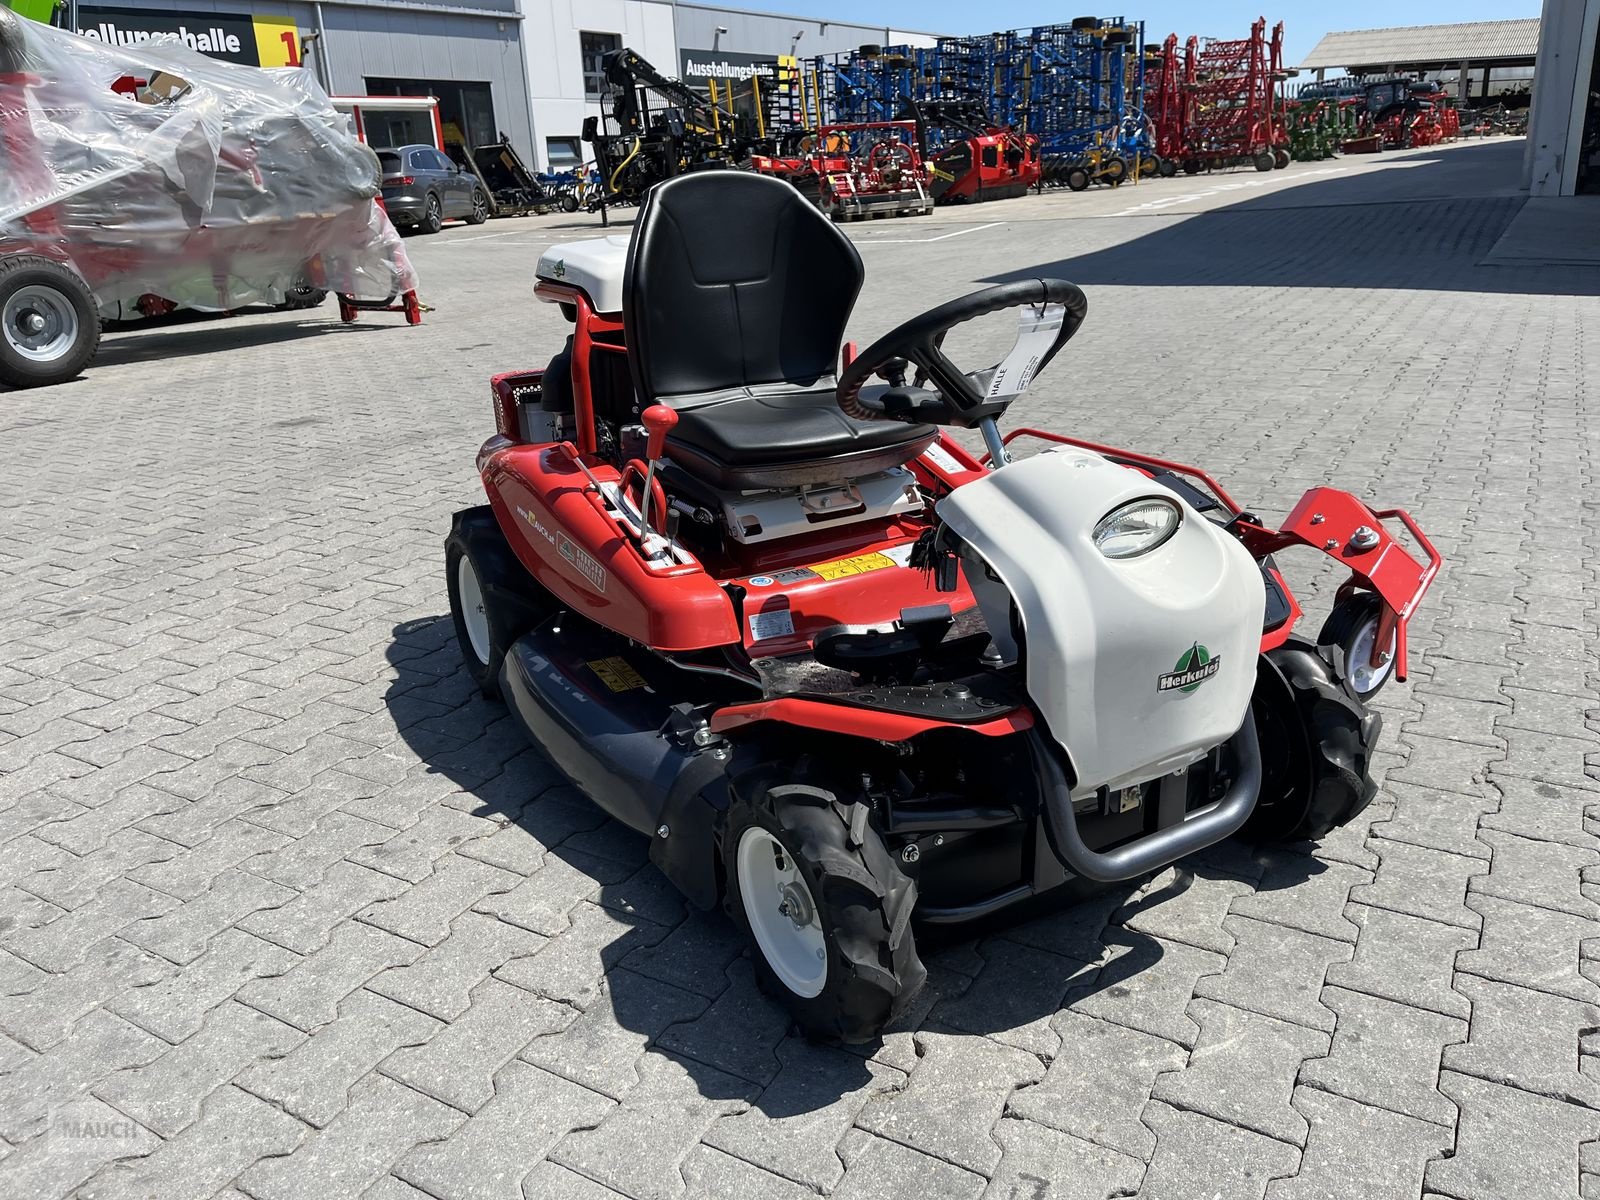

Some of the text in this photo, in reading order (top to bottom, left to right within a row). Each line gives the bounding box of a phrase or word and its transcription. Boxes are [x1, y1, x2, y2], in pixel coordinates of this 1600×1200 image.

[281, 31, 300, 67] 1
[991, 368, 1008, 396] HALLE
[1160, 664, 1219, 690] Herkules
